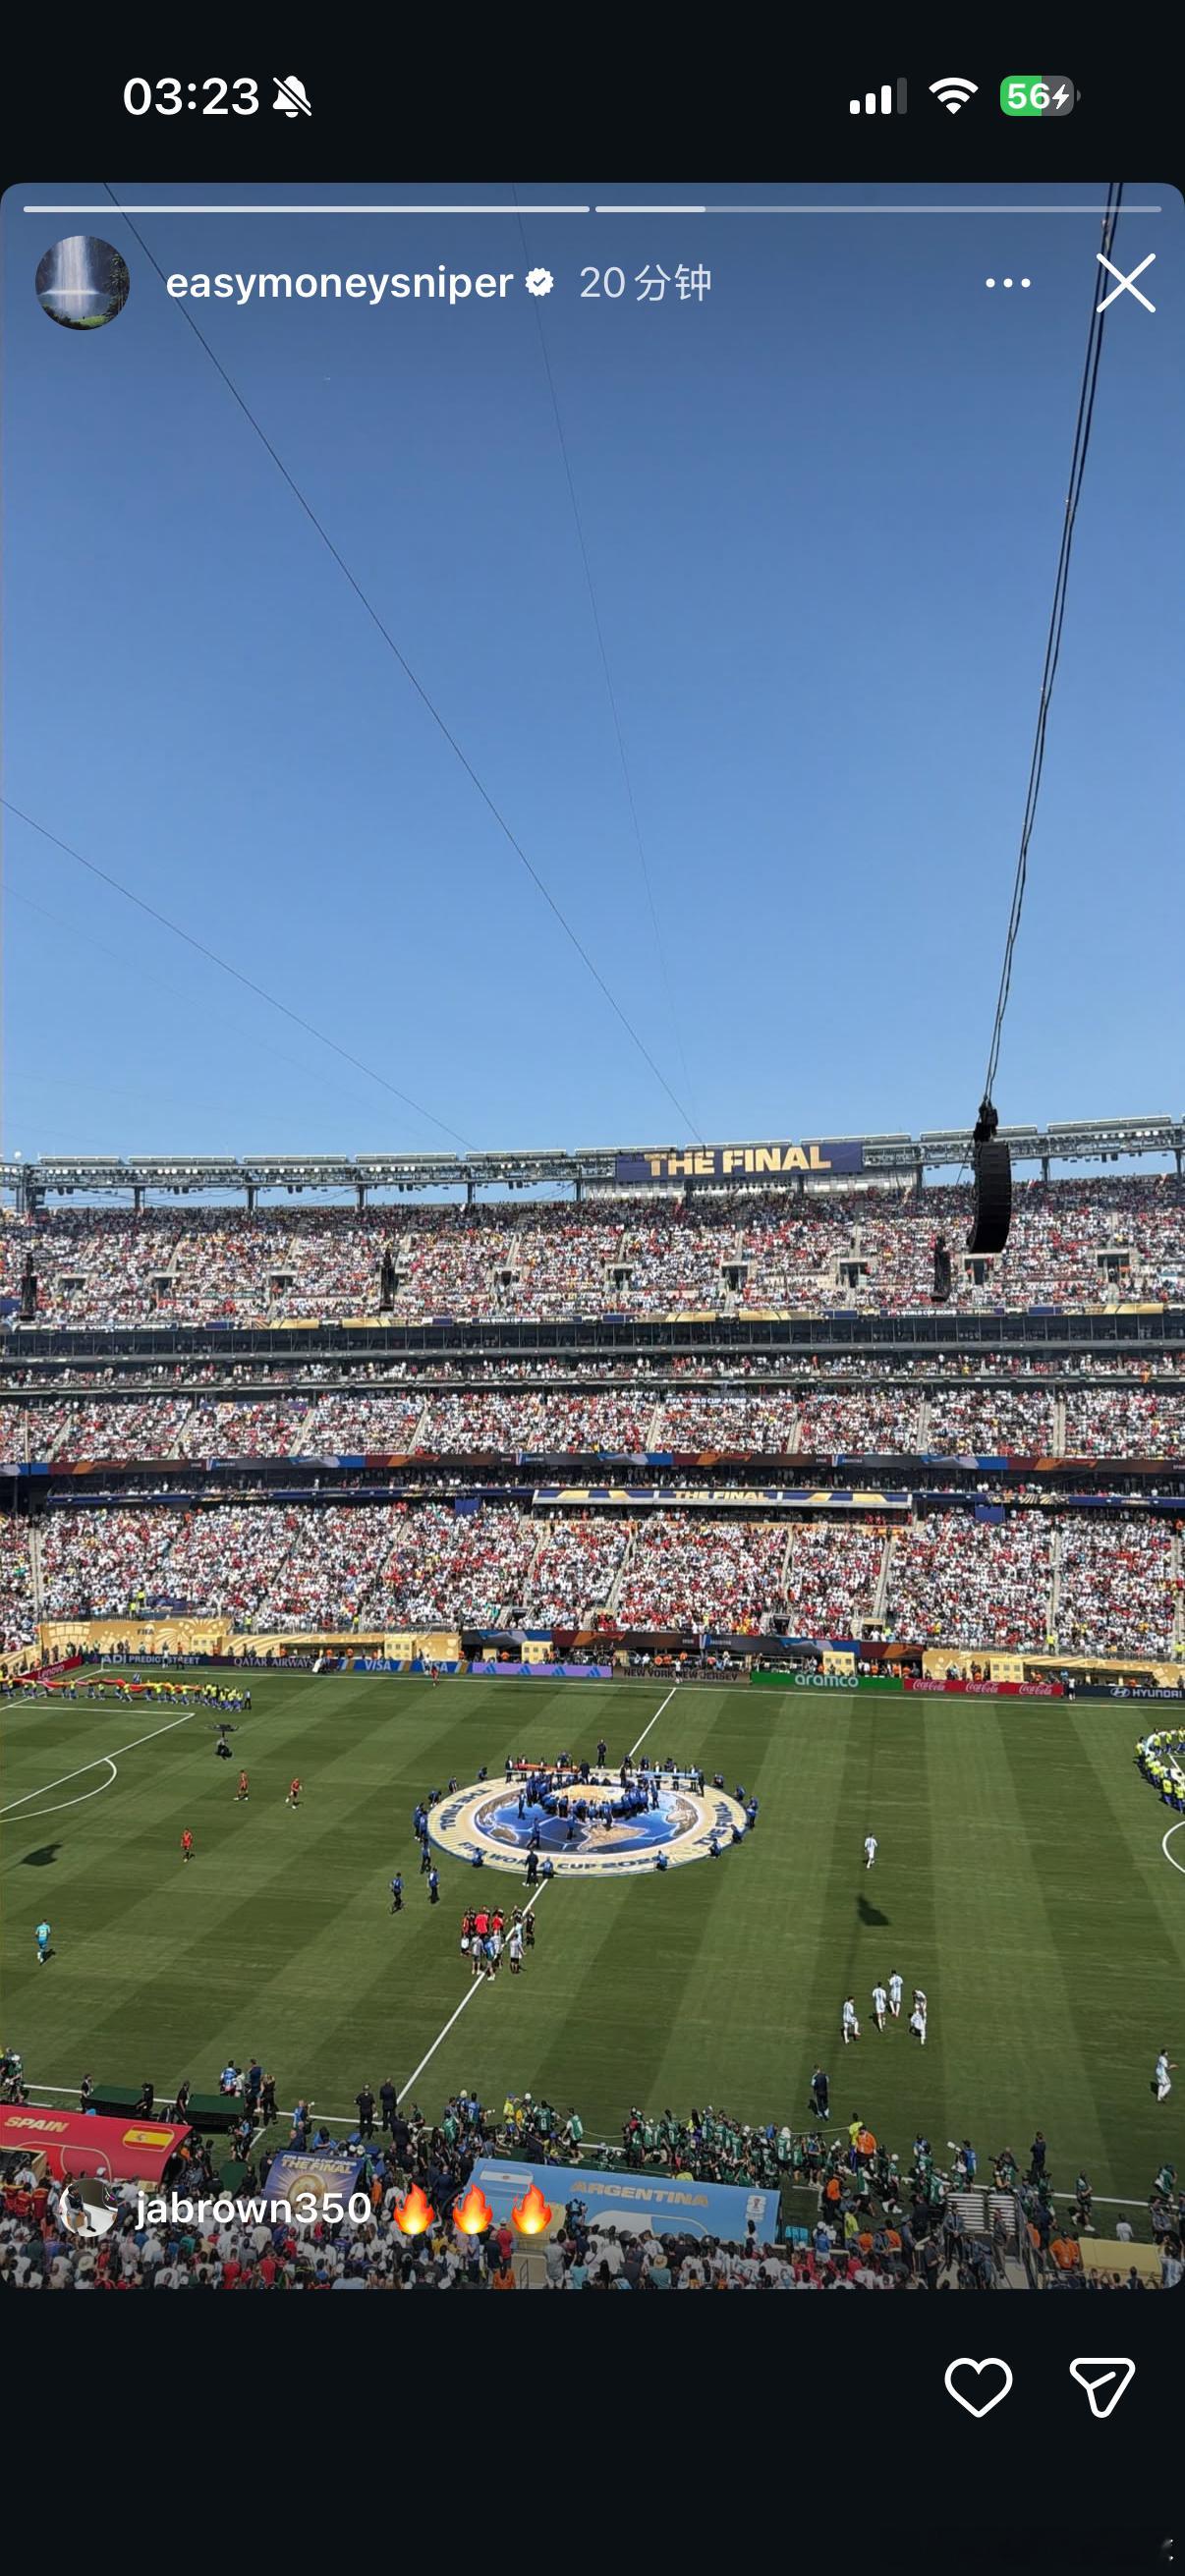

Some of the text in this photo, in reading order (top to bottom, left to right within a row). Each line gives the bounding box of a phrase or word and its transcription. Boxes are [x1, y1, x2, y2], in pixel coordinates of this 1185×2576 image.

[644, 1146, 832, 1177] THE FINAL
[673, 1490, 769, 1502] THE FINAL
[129, 1654, 200, 1665] PREDICSTREET
[234, 1657, 315, 1669] QATAR AIRWAYS
[365, 1659, 392, 1671] VISA
[623, 1666, 646, 1677] NEW
[648, 1667, 674, 1679] YORK
[794, 1673, 859, 1688] aramco
[1132, 1689, 1183, 1700] HYUNDAI
[440, 1788, 493, 1831] THE FINAL
[693, 1801, 734, 1846] THE FINAL
[4, 2116, 70, 2133] SPAIN
[281, 2158, 353, 2174] THE FINAL
[569, 2180, 709, 2208] ARGENTINA
